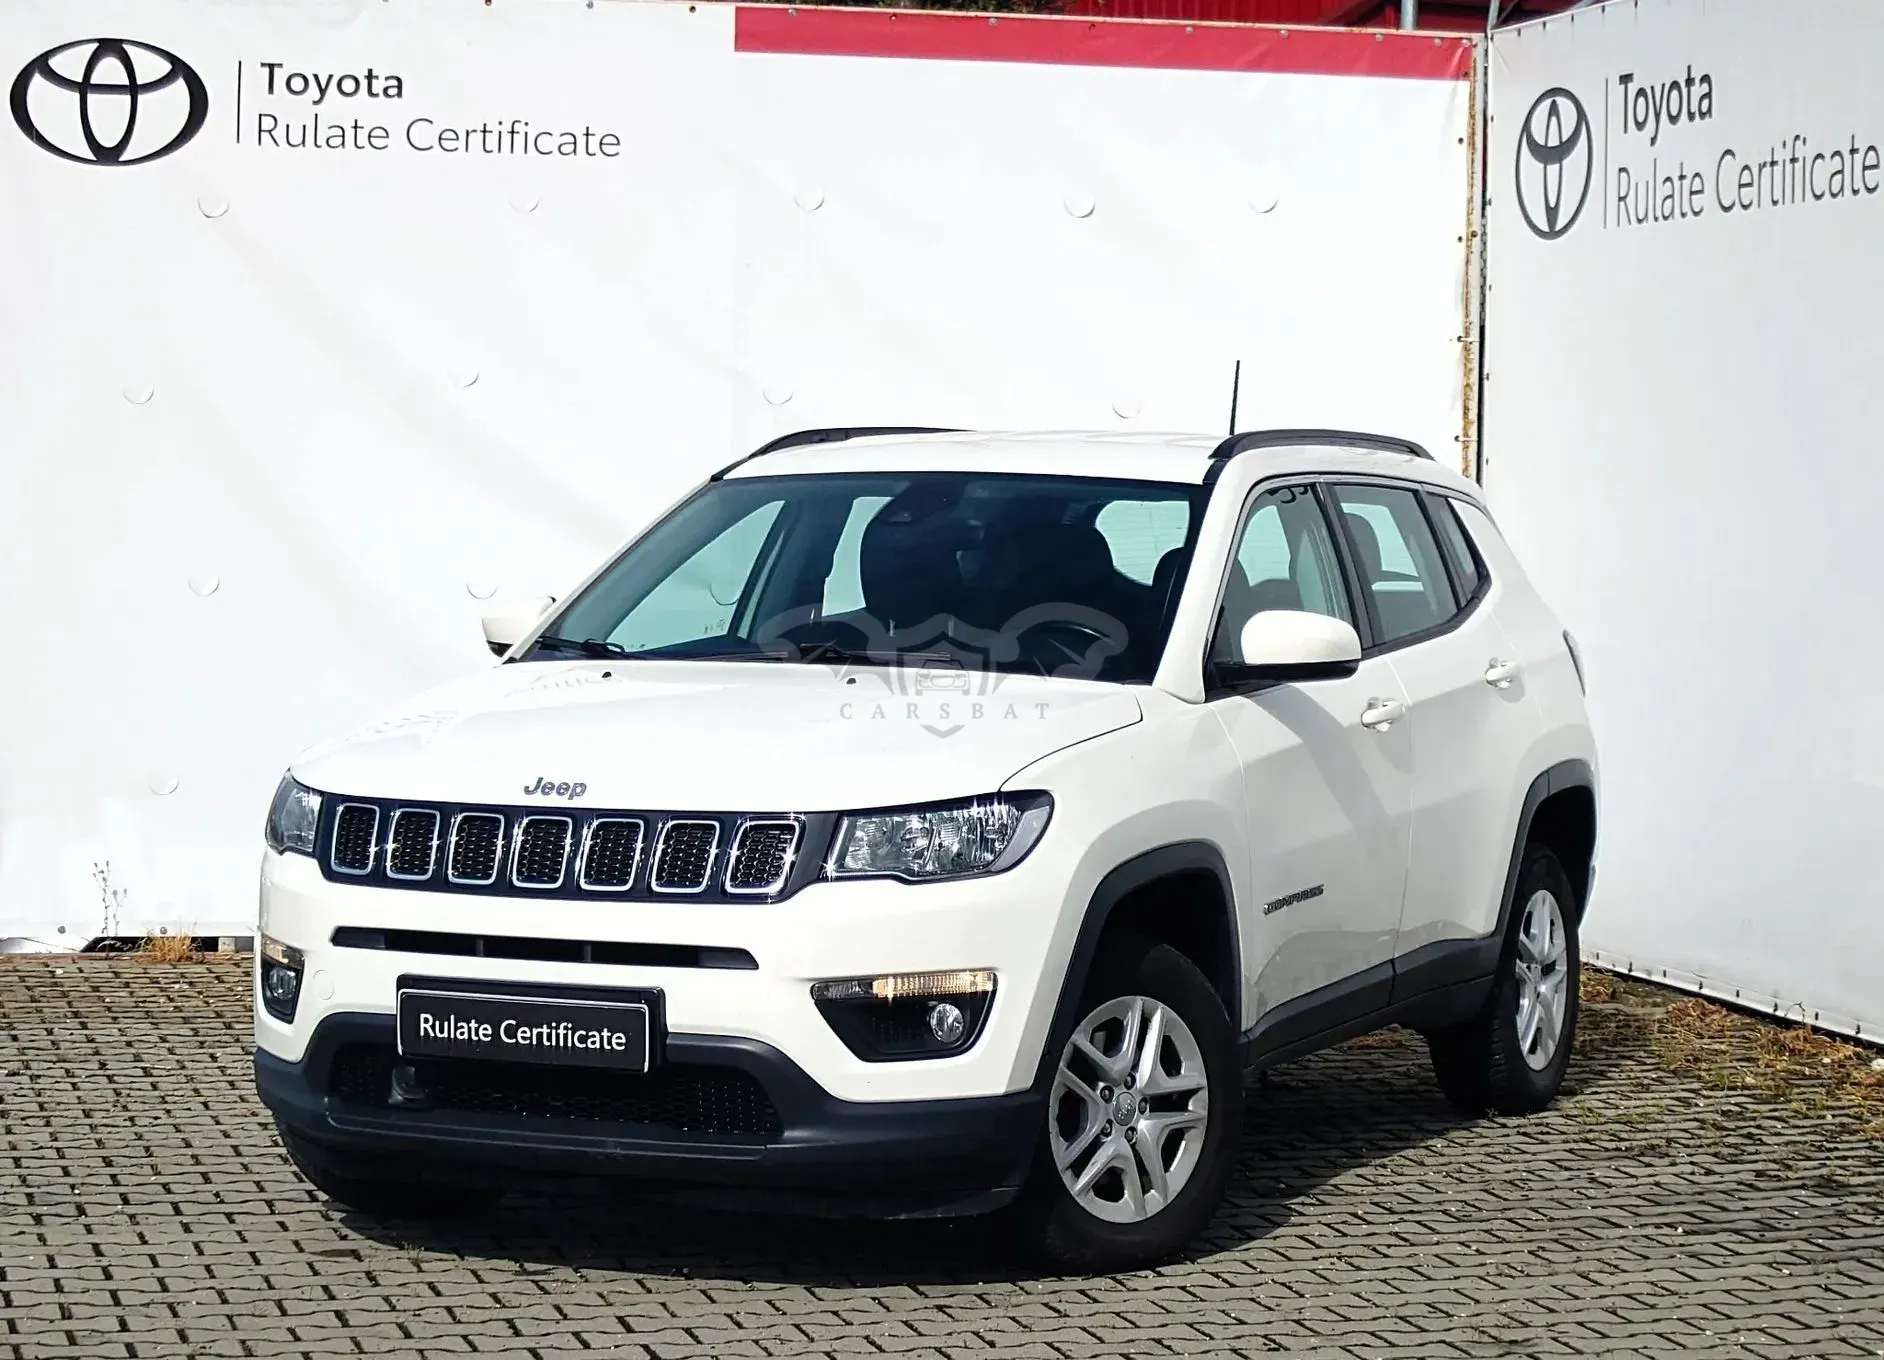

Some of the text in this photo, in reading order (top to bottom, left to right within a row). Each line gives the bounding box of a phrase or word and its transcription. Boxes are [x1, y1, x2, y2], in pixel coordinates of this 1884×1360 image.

[260, 62, 404, 104] Toyota
[1618, 64, 1714, 147] Toyota
[257, 113, 622, 158] Rulate Certificate
[1617, 133, 1881, 228] Rulate Certificate
[523, 776, 587, 800] Jeep
[419, 1013, 626, 1050] Rulate Certificate
